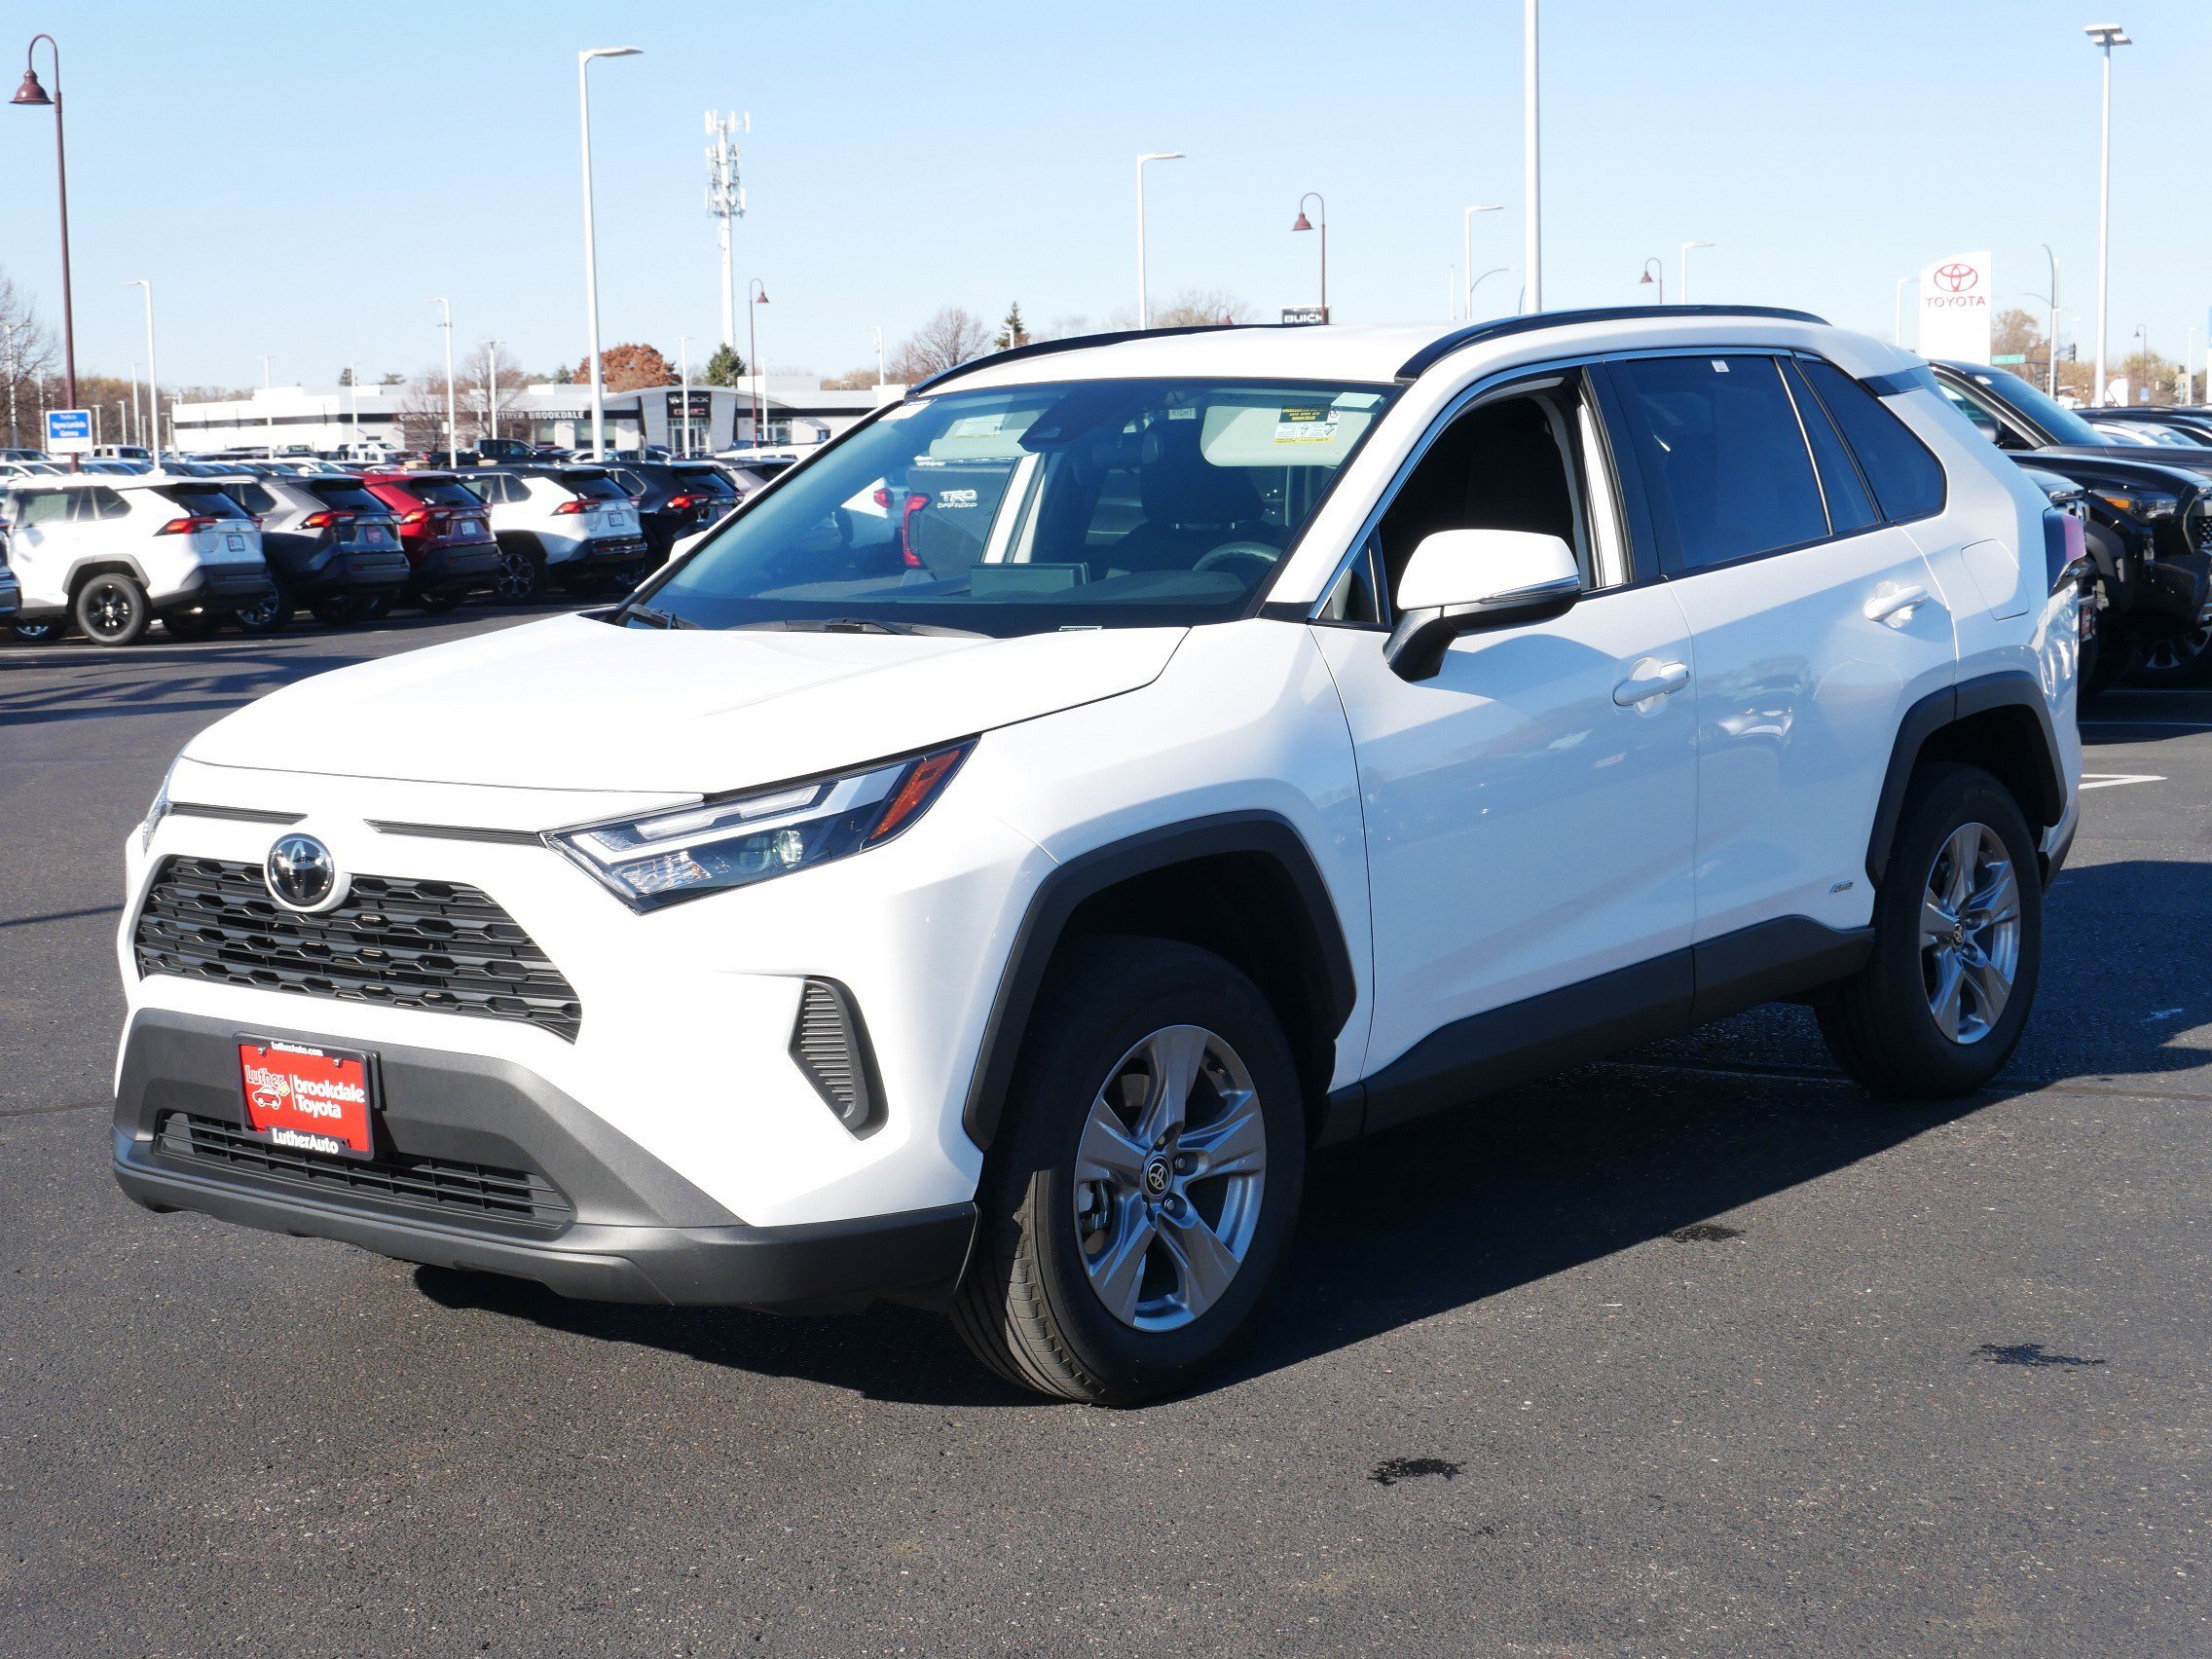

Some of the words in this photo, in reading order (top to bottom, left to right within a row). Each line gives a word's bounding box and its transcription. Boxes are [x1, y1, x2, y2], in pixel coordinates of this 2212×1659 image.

[1926, 295, 1986, 308] TOYOTA
[1283, 313, 1323, 323] BUICK
[529, 410, 585, 421] BROOKDALE
[940, 489, 977, 502] TRD
[245, 1064, 285, 1088] Luther
[293, 1074, 365, 1103] brookdale
[295, 1093, 343, 1119] Toyota
[272, 1126, 339, 1155] LutherAuto
